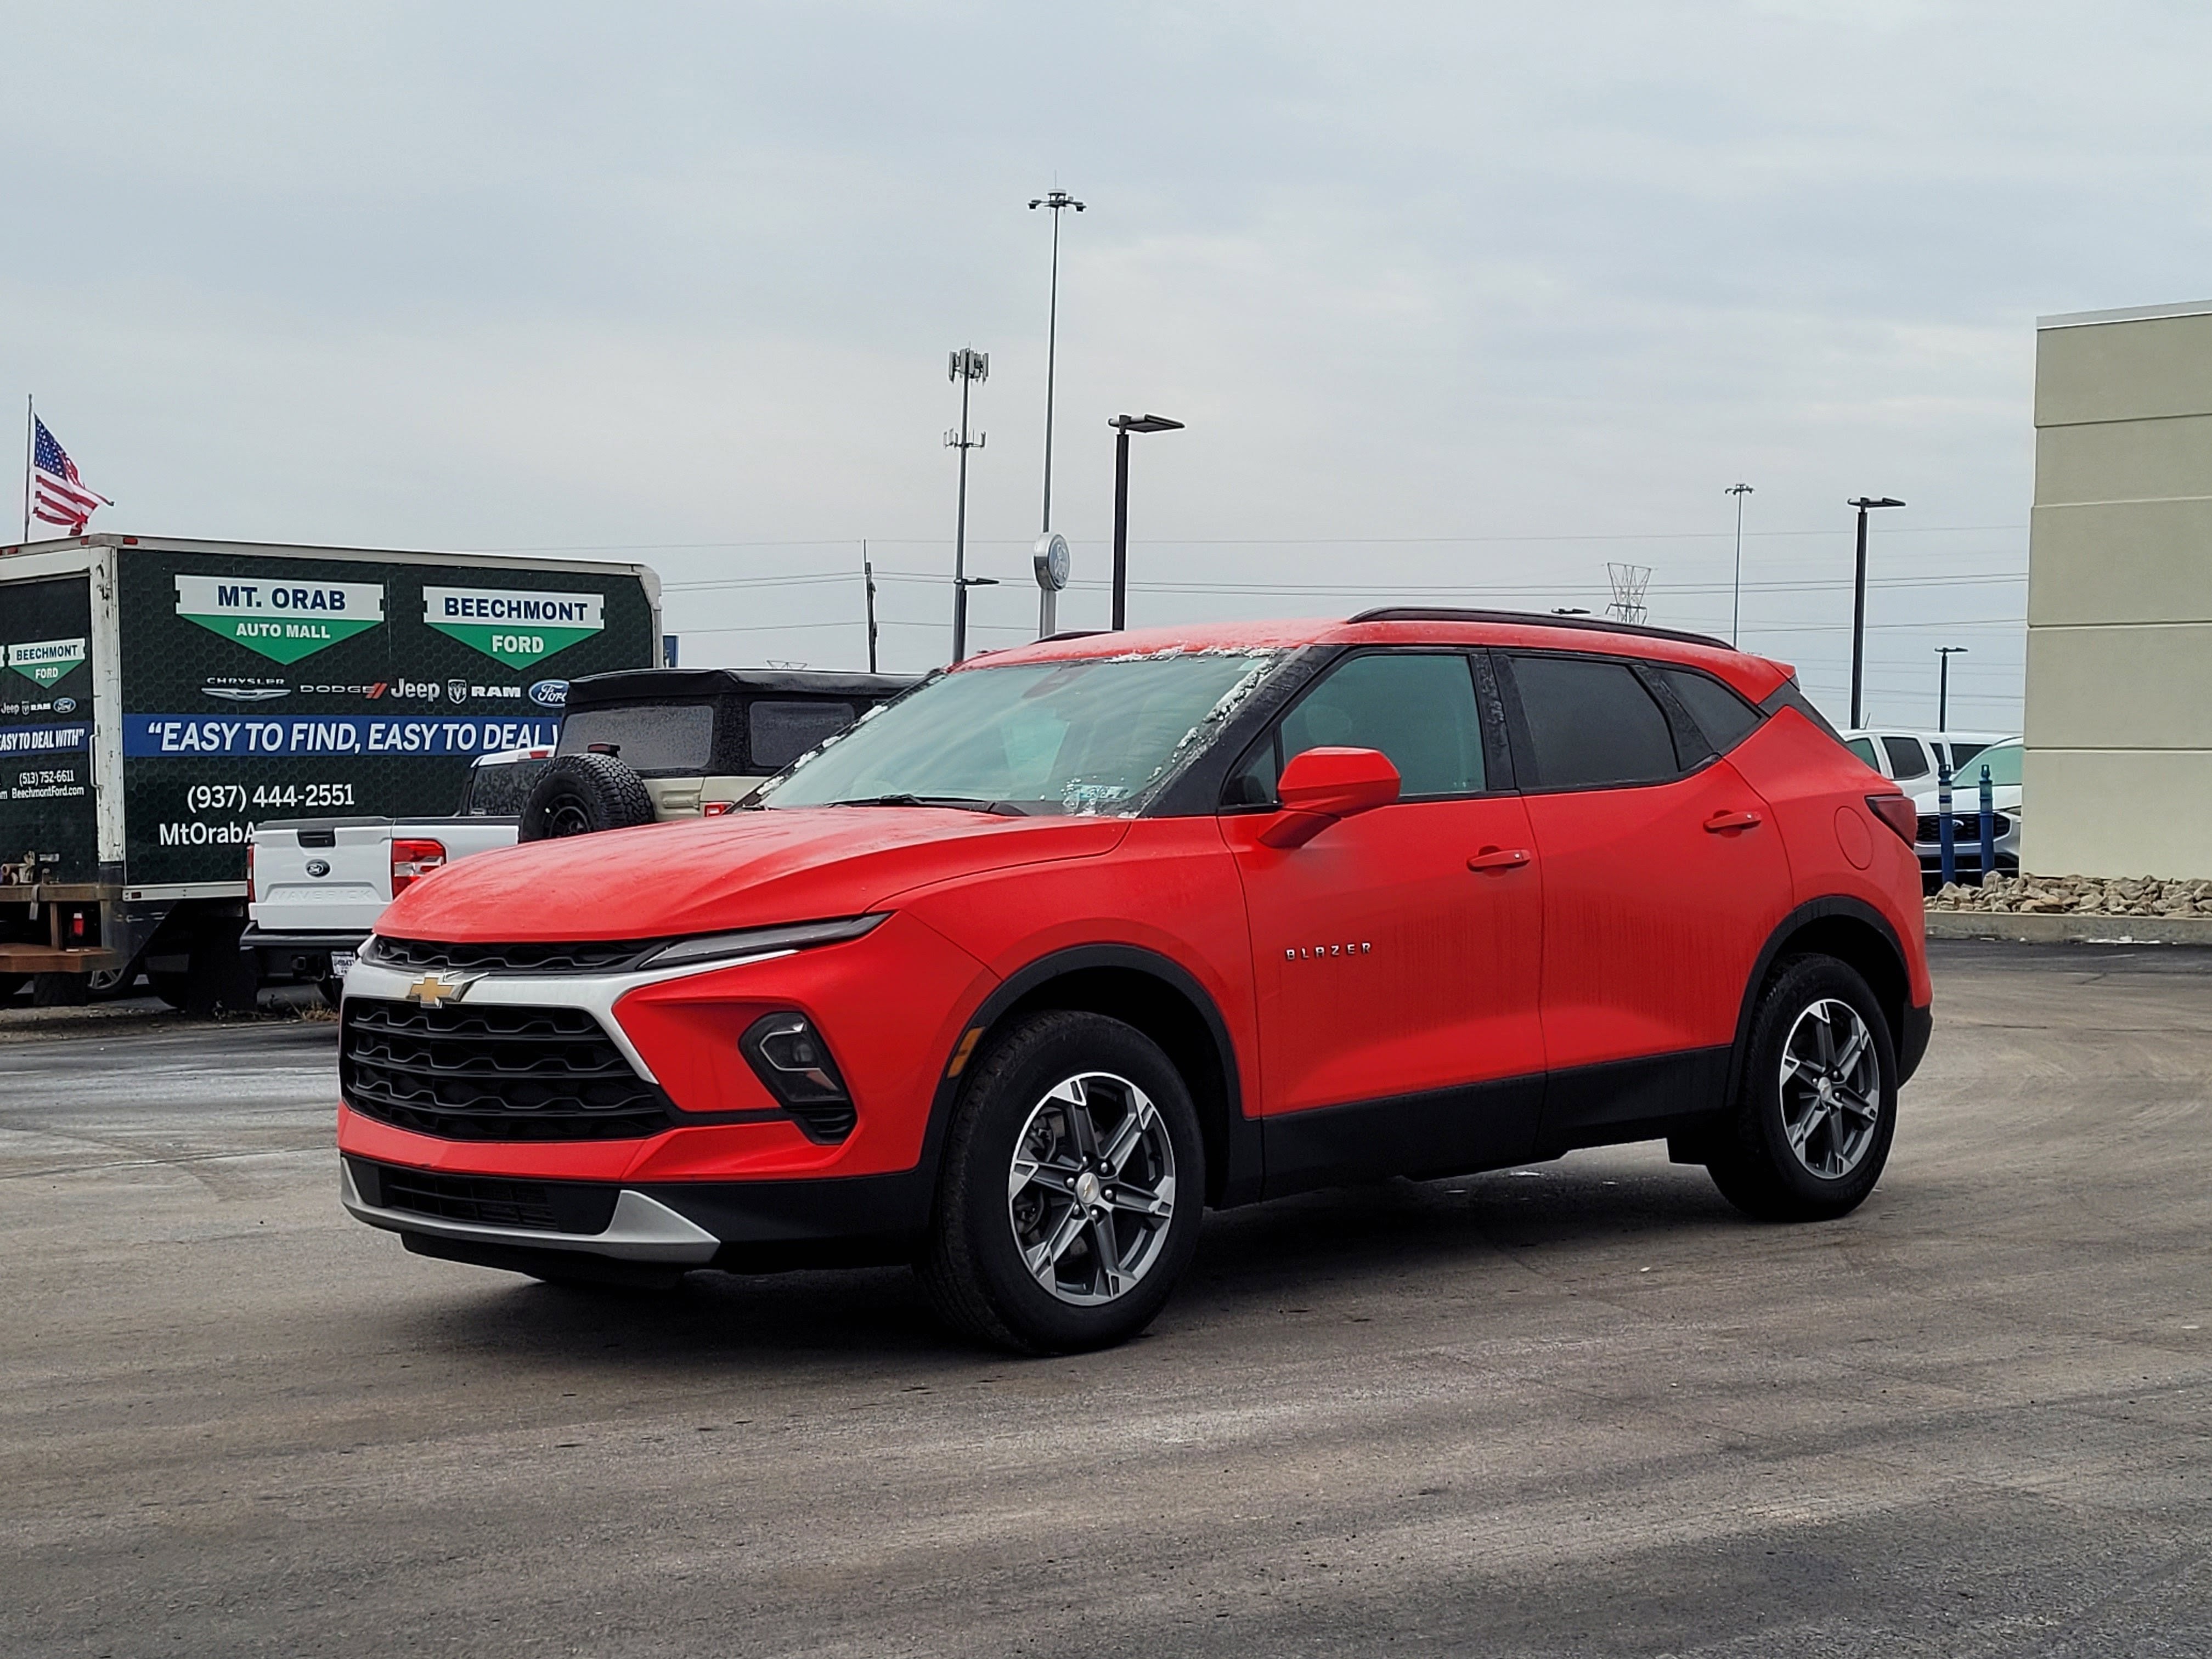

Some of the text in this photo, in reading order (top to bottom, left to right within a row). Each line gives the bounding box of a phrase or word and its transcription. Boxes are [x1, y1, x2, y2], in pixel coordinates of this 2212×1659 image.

[218, 585, 346, 610] MT. ORAB
[444, 597, 588, 621] BEECHMONT
[236, 623, 331, 639] AUTO MALL
[16, 644, 78, 661] BEECHMONT
[492, 635, 544, 653] FORD
[35, 667, 58, 679] FORD
[206, 677, 285, 685] CHRYSLER
[300, 685, 375, 693] DODGE
[391, 678, 441, 702] Jeep
[471, 686, 521, 698] RAM
[1, 702, 19, 714] Jeep
[18, 732, 31, 750] TO
[31, 730, 54, 749] DEAL
[245, 723, 283, 751] TO
[290, 723, 360, 754] FIND,
[368, 723, 439, 751] EASY
[443, 724, 477, 751] TO
[19, 770, 75, 787] (513) 752-6611
[12, 785, 84, 799] BeechmontFord.com
[187, 784, 355, 813] (937) 444-2551
[1286, 942, 1371, 960] BLAZER
